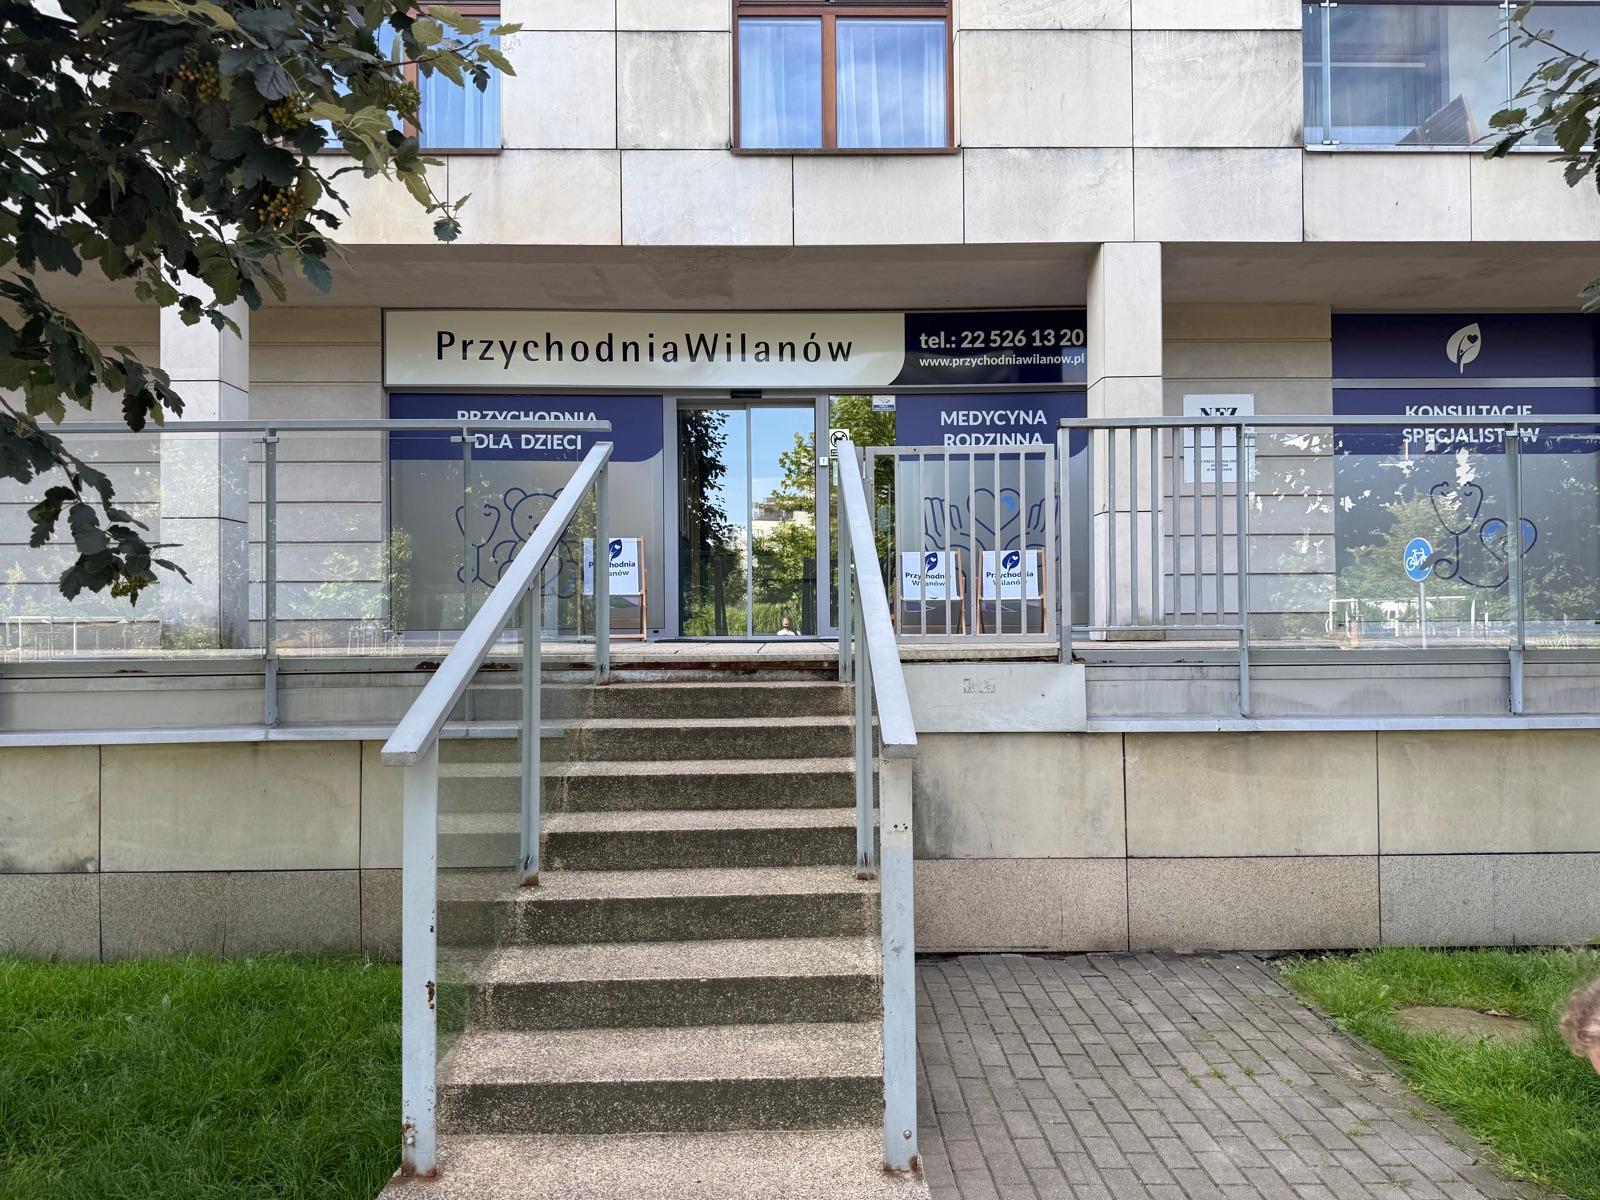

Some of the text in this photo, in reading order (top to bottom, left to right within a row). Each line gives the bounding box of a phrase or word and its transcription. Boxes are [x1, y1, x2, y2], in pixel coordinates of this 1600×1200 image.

[919, 328, 1085, 349] tel.: 22 526 13 20
[919, 352, 1085, 368] www.przychodniawilanow.pl
[940, 409, 1048, 426] MEDYCYNA
[474, 433, 582, 450] DLA DZIECI
[943, 432, 1044, 446] RODZINNA
[1402, 427, 1540, 443] SPECJALISTW
